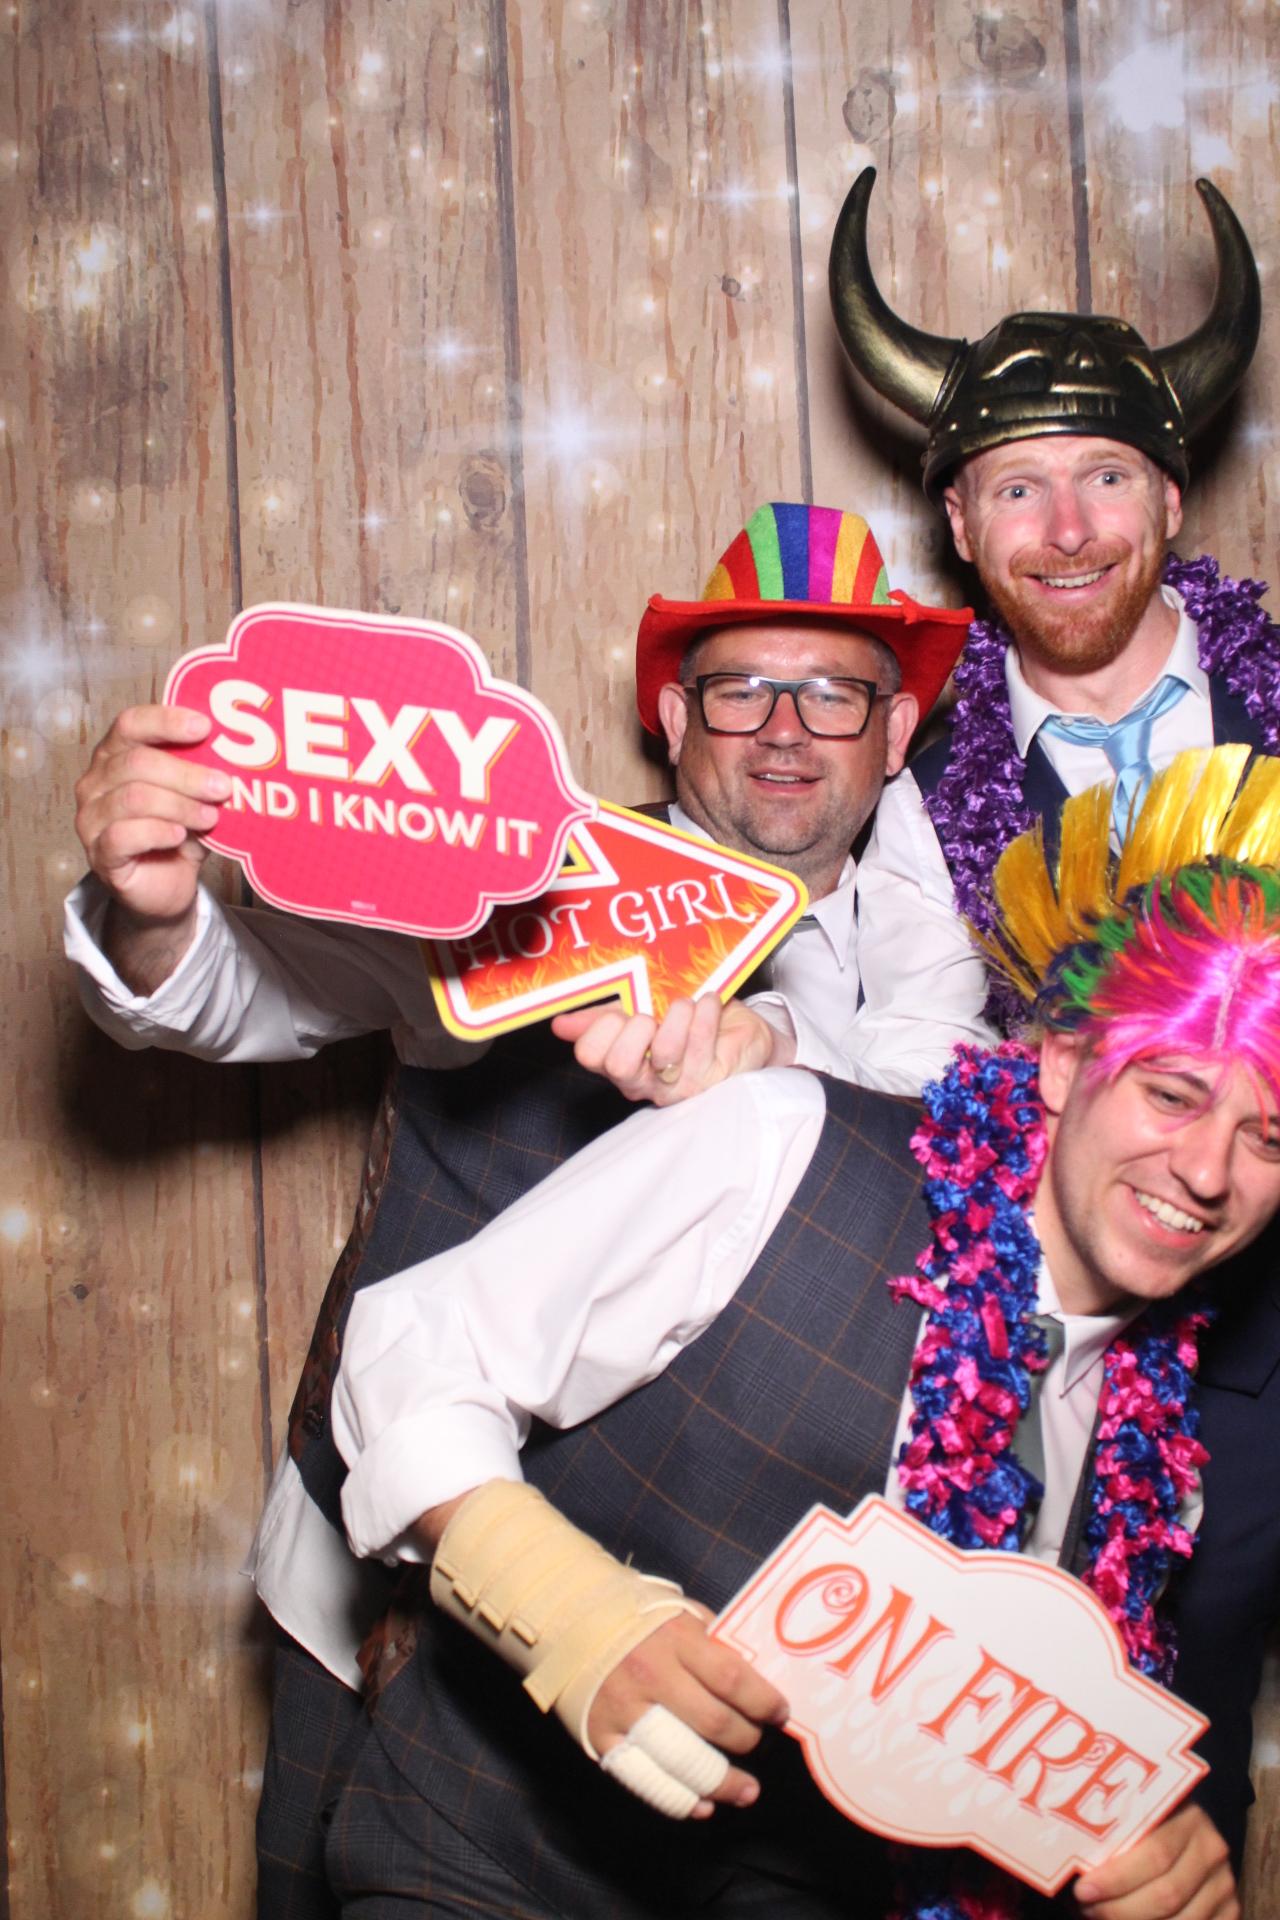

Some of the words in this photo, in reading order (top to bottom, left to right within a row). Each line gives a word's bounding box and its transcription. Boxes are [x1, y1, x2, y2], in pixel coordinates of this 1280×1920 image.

[208, 679, 520, 803] SEXY
[224, 776, 298, 821] ND
[309, 788, 323, 826] I
[333, 790, 487, 850] KNOW
[495, 816, 540, 858] IT
[455, 899, 592, 971] HOT
[608, 873, 757, 944] GIRL
[774, 1563, 955, 1704] ON
[918, 1646, 1161, 1842] FIRE
